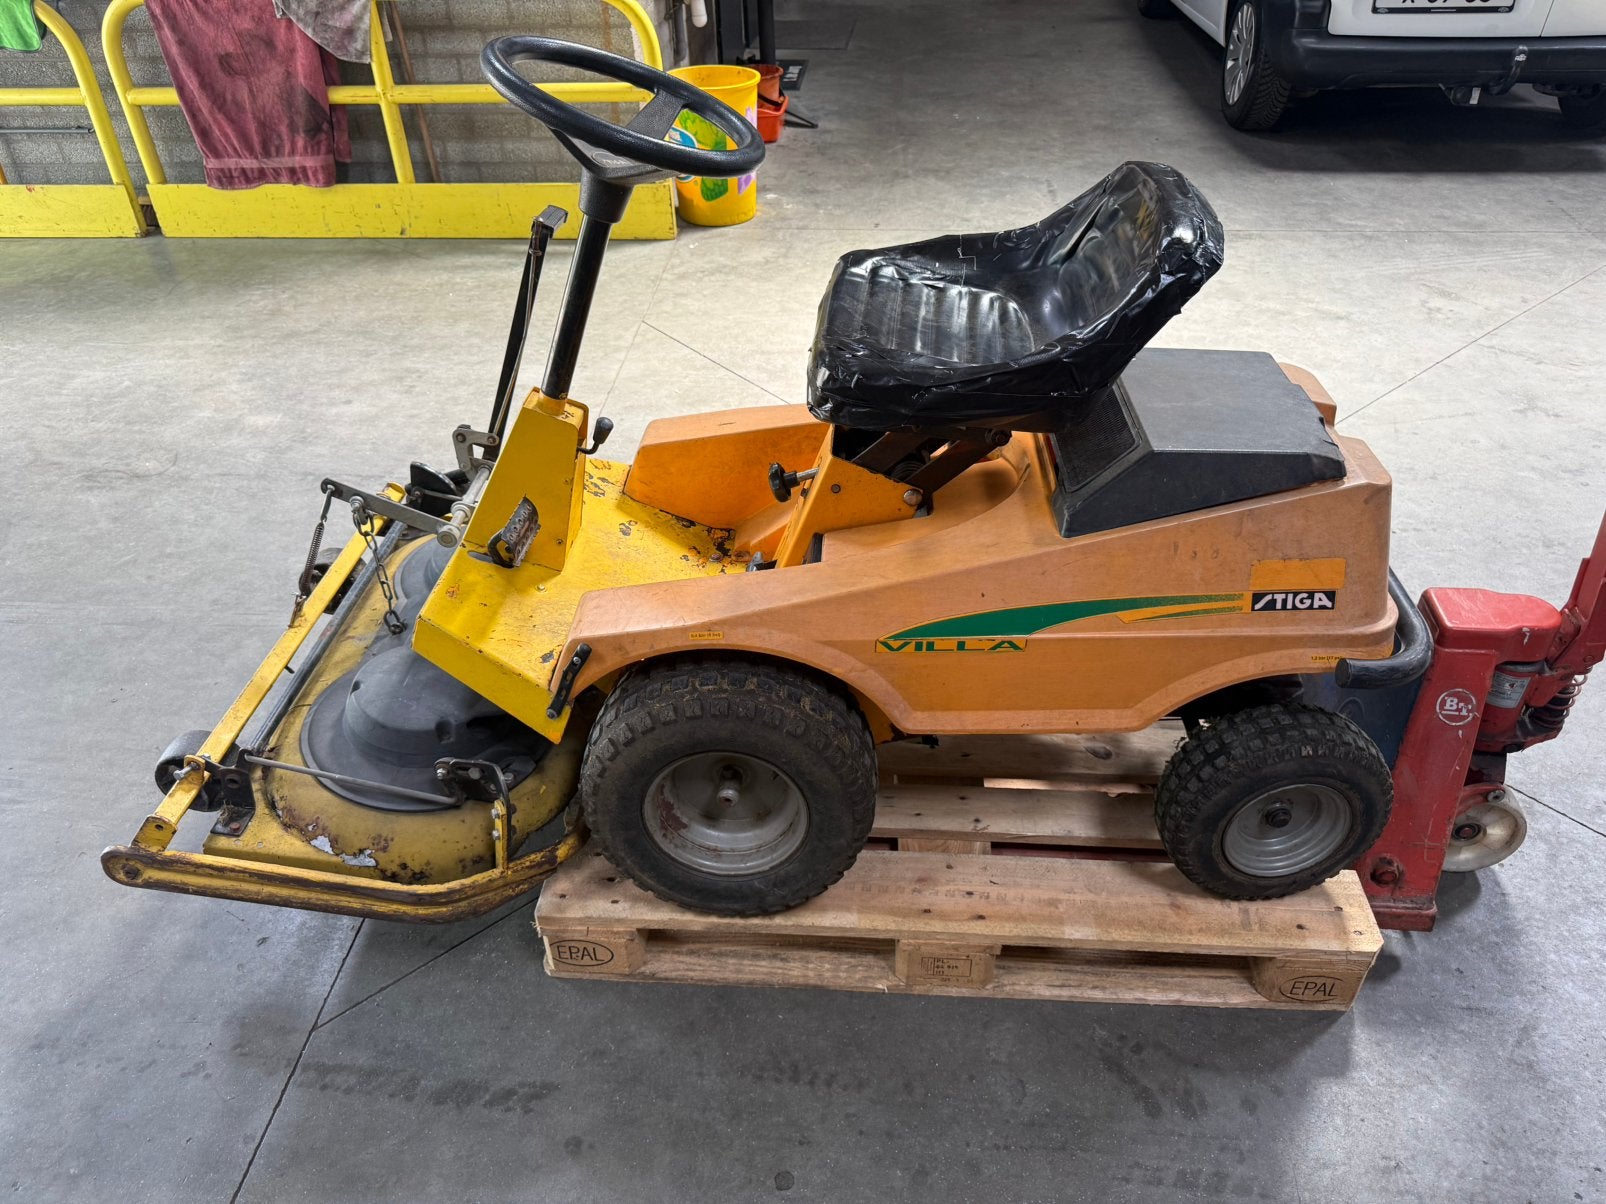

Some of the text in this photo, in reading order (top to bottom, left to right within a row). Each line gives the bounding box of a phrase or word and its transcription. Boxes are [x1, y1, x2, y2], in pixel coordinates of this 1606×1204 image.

[1253, 592, 1333, 610] STIGA
[878, 640, 1025, 652] VILLA
[1443, 696, 1473, 716] BT
[556, 944, 606, 962] EPAL
[1289, 980, 1338, 997] EPAL
